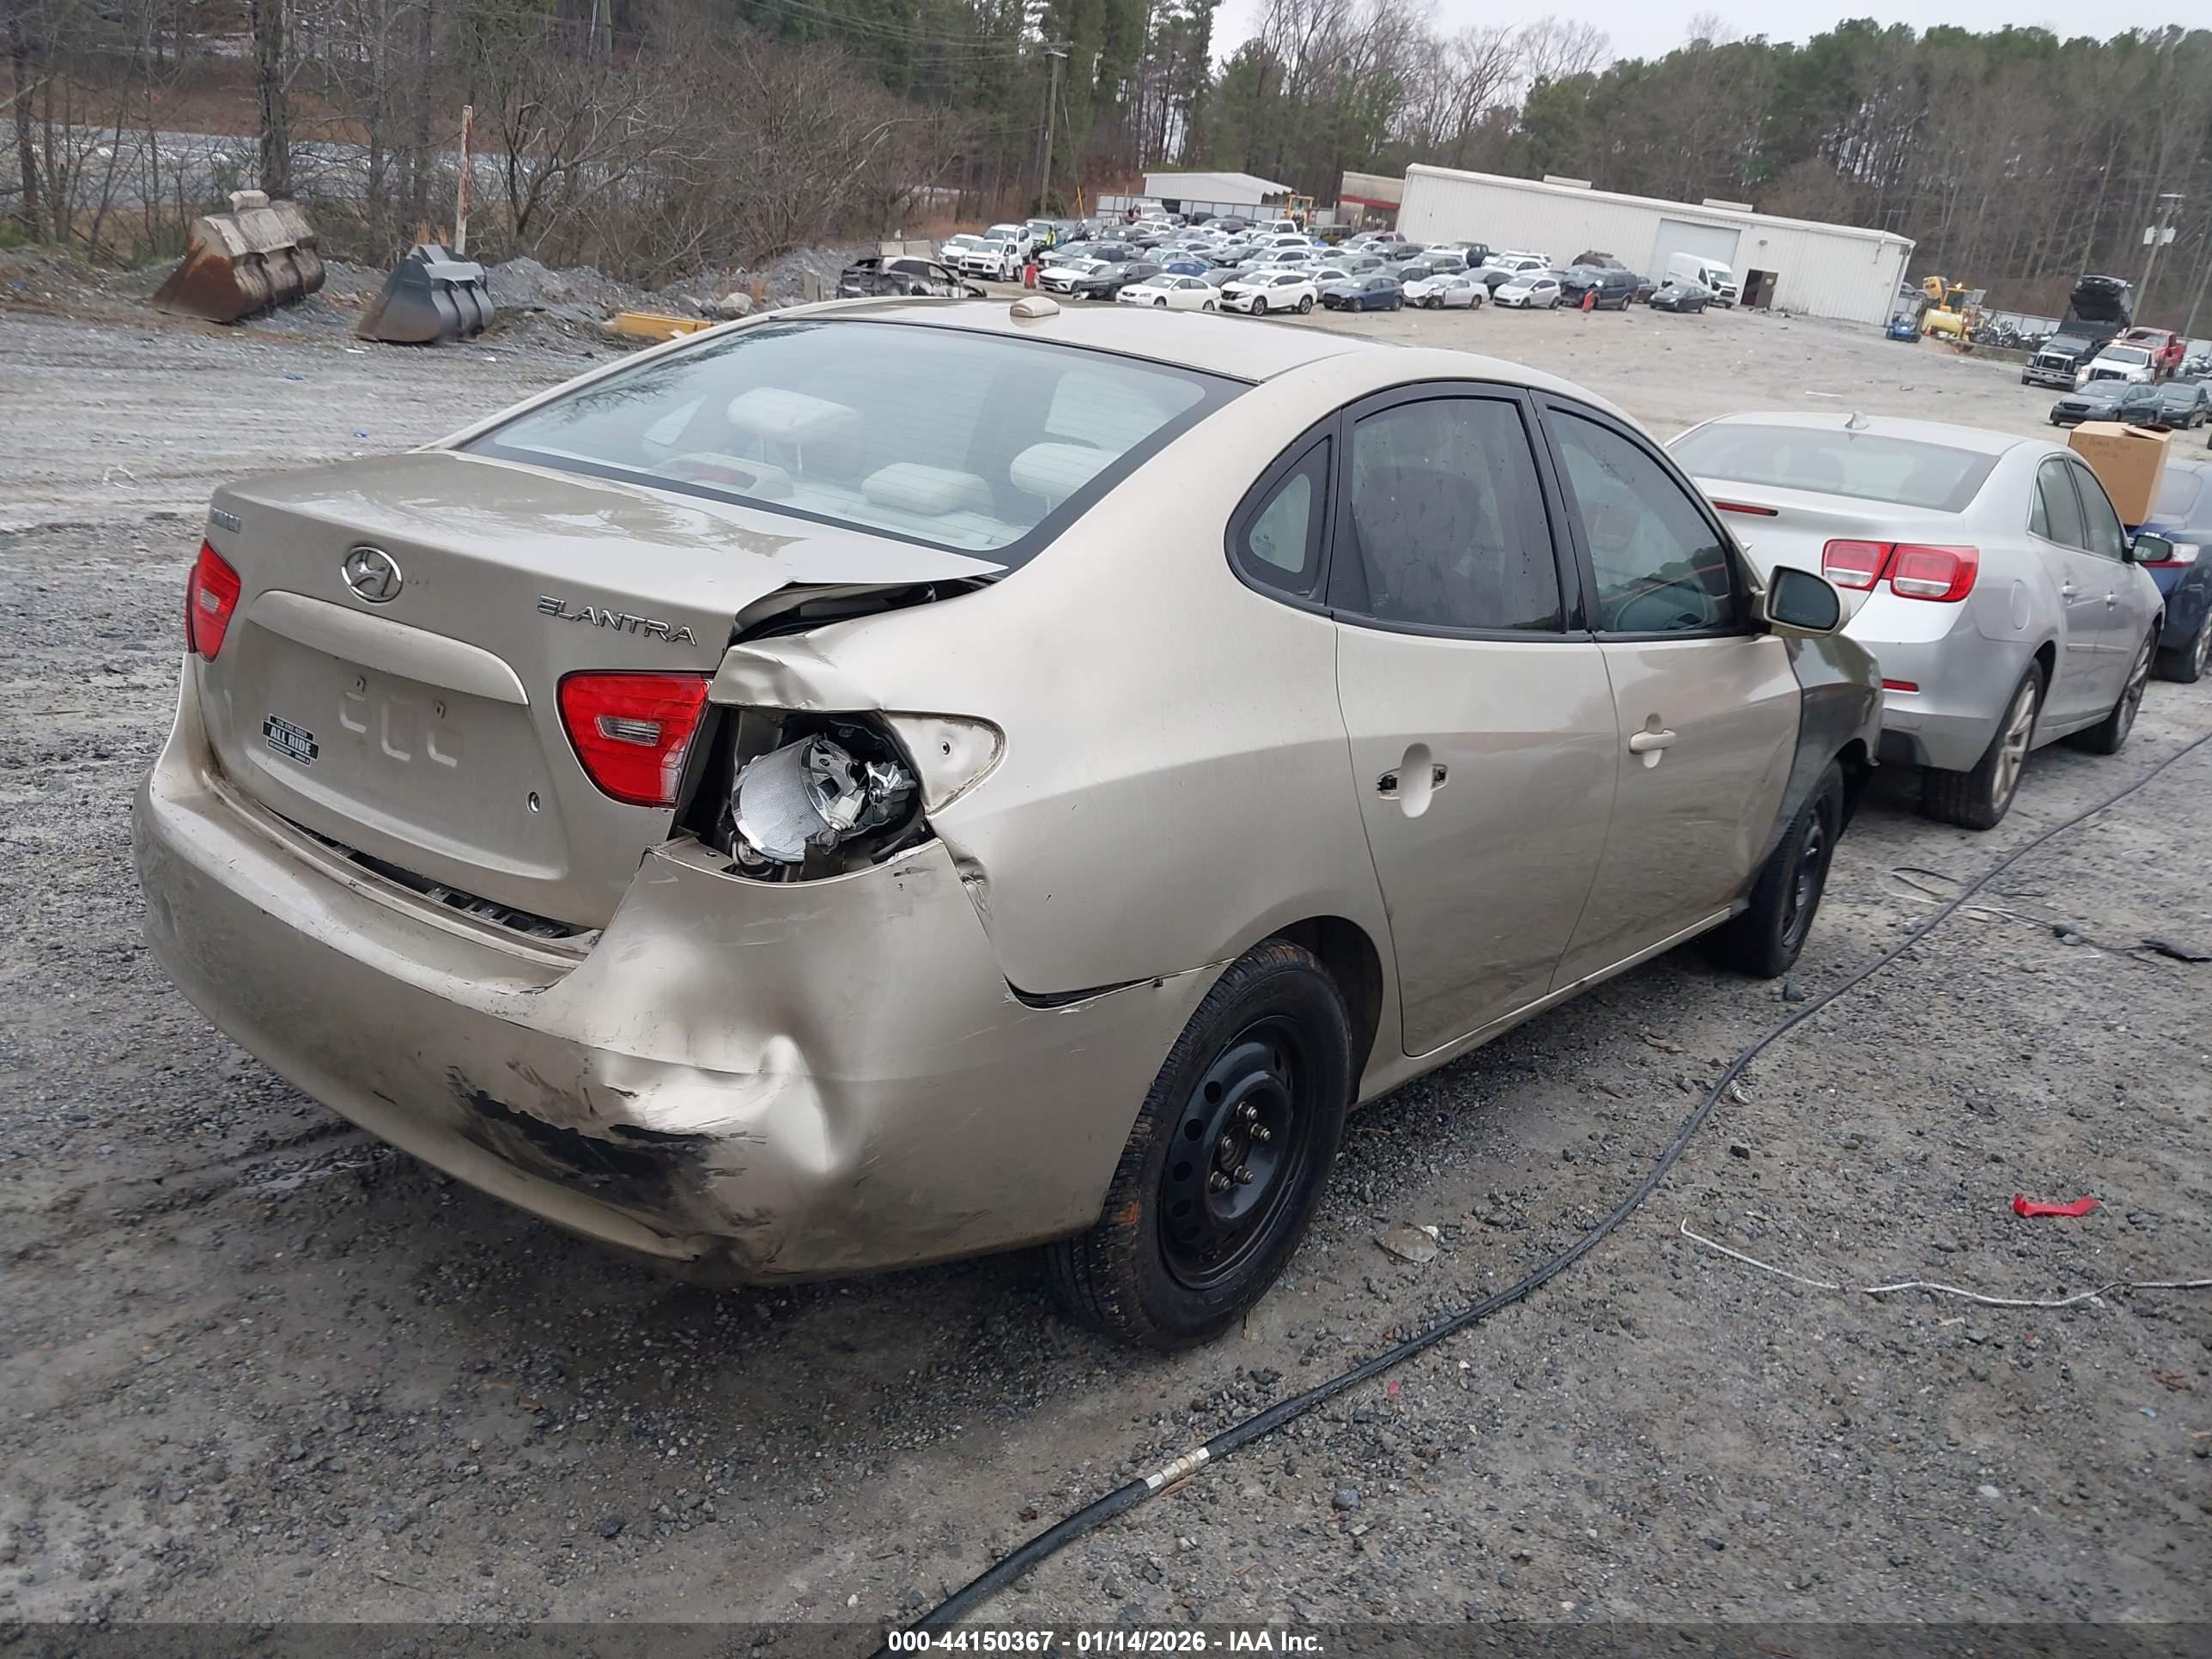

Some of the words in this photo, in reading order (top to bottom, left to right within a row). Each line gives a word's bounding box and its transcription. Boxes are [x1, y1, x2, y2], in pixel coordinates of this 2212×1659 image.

[537, 595, 697, 646] ELANTRA
[270, 726, 287, 744] ALL
[288, 733, 312, 755] RIDE
